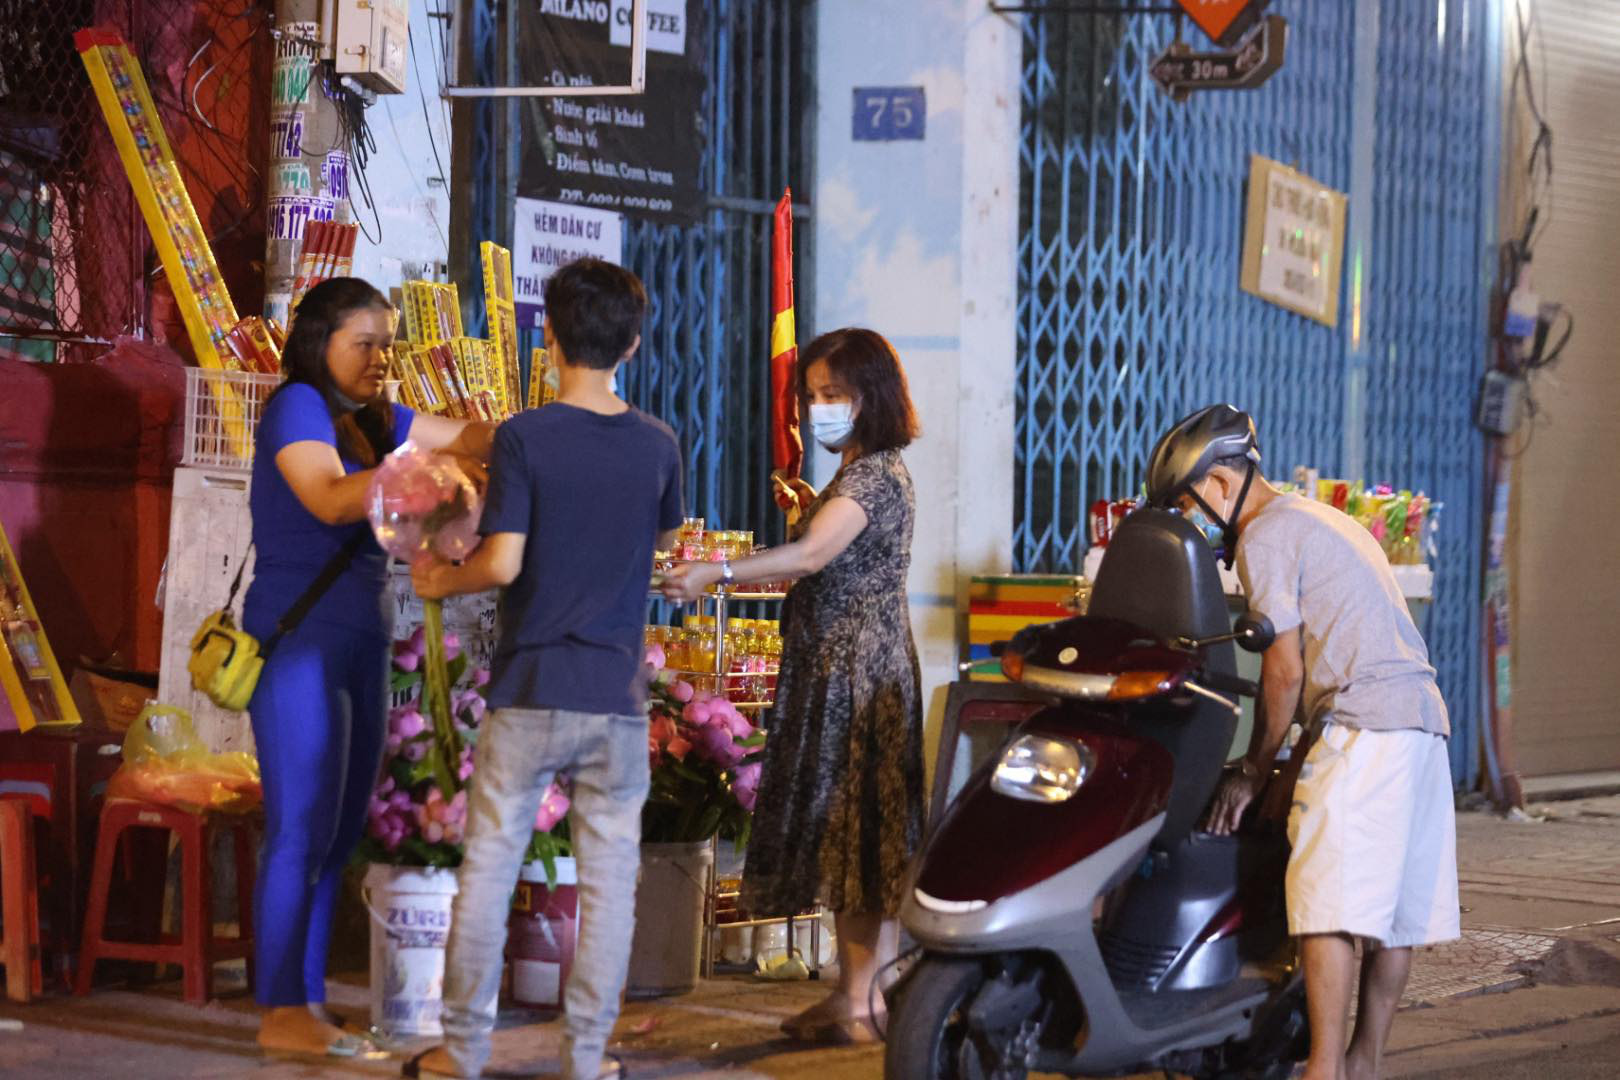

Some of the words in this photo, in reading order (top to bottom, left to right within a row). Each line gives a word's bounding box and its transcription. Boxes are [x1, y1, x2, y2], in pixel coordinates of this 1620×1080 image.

[540, 0, 609, 24] MILANO
[616, 7, 679, 34] CFEE
[1191, 60, 1228, 79] 30m
[866, 96, 912, 129] 75
[561, 213, 584, 238] DÂN
[586, 220, 602, 240] CƯ
